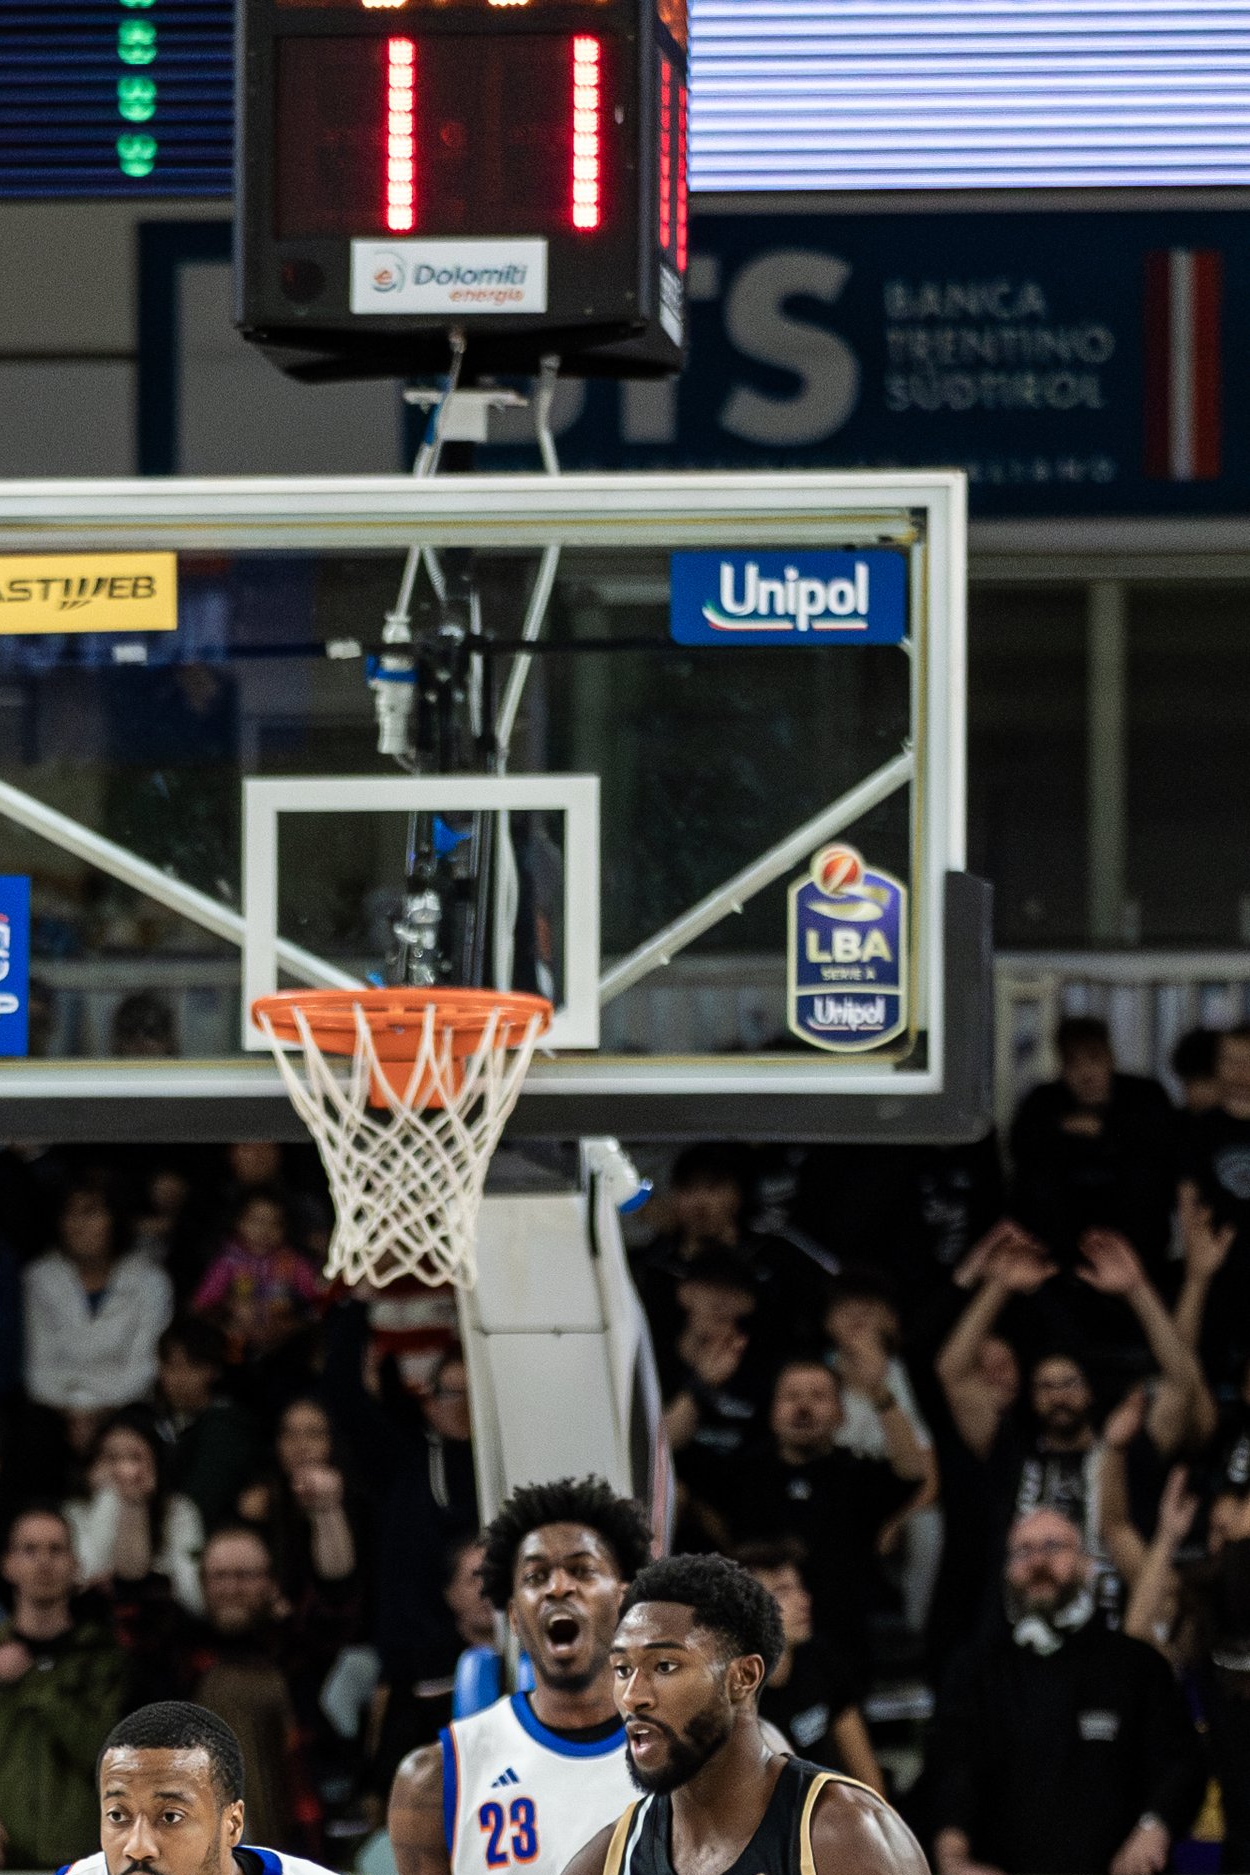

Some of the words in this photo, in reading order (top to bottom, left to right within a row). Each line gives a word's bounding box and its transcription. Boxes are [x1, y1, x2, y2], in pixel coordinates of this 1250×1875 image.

[412, 264, 528, 287] Dolomiti
[886, 324, 1116, 365] TRENTINO
[720, 562, 869, 631] Unipol
[806, 927, 893, 963] LBA
[813, 996, 886, 1032] Unipol
[479, 1797, 540, 1870] 23
